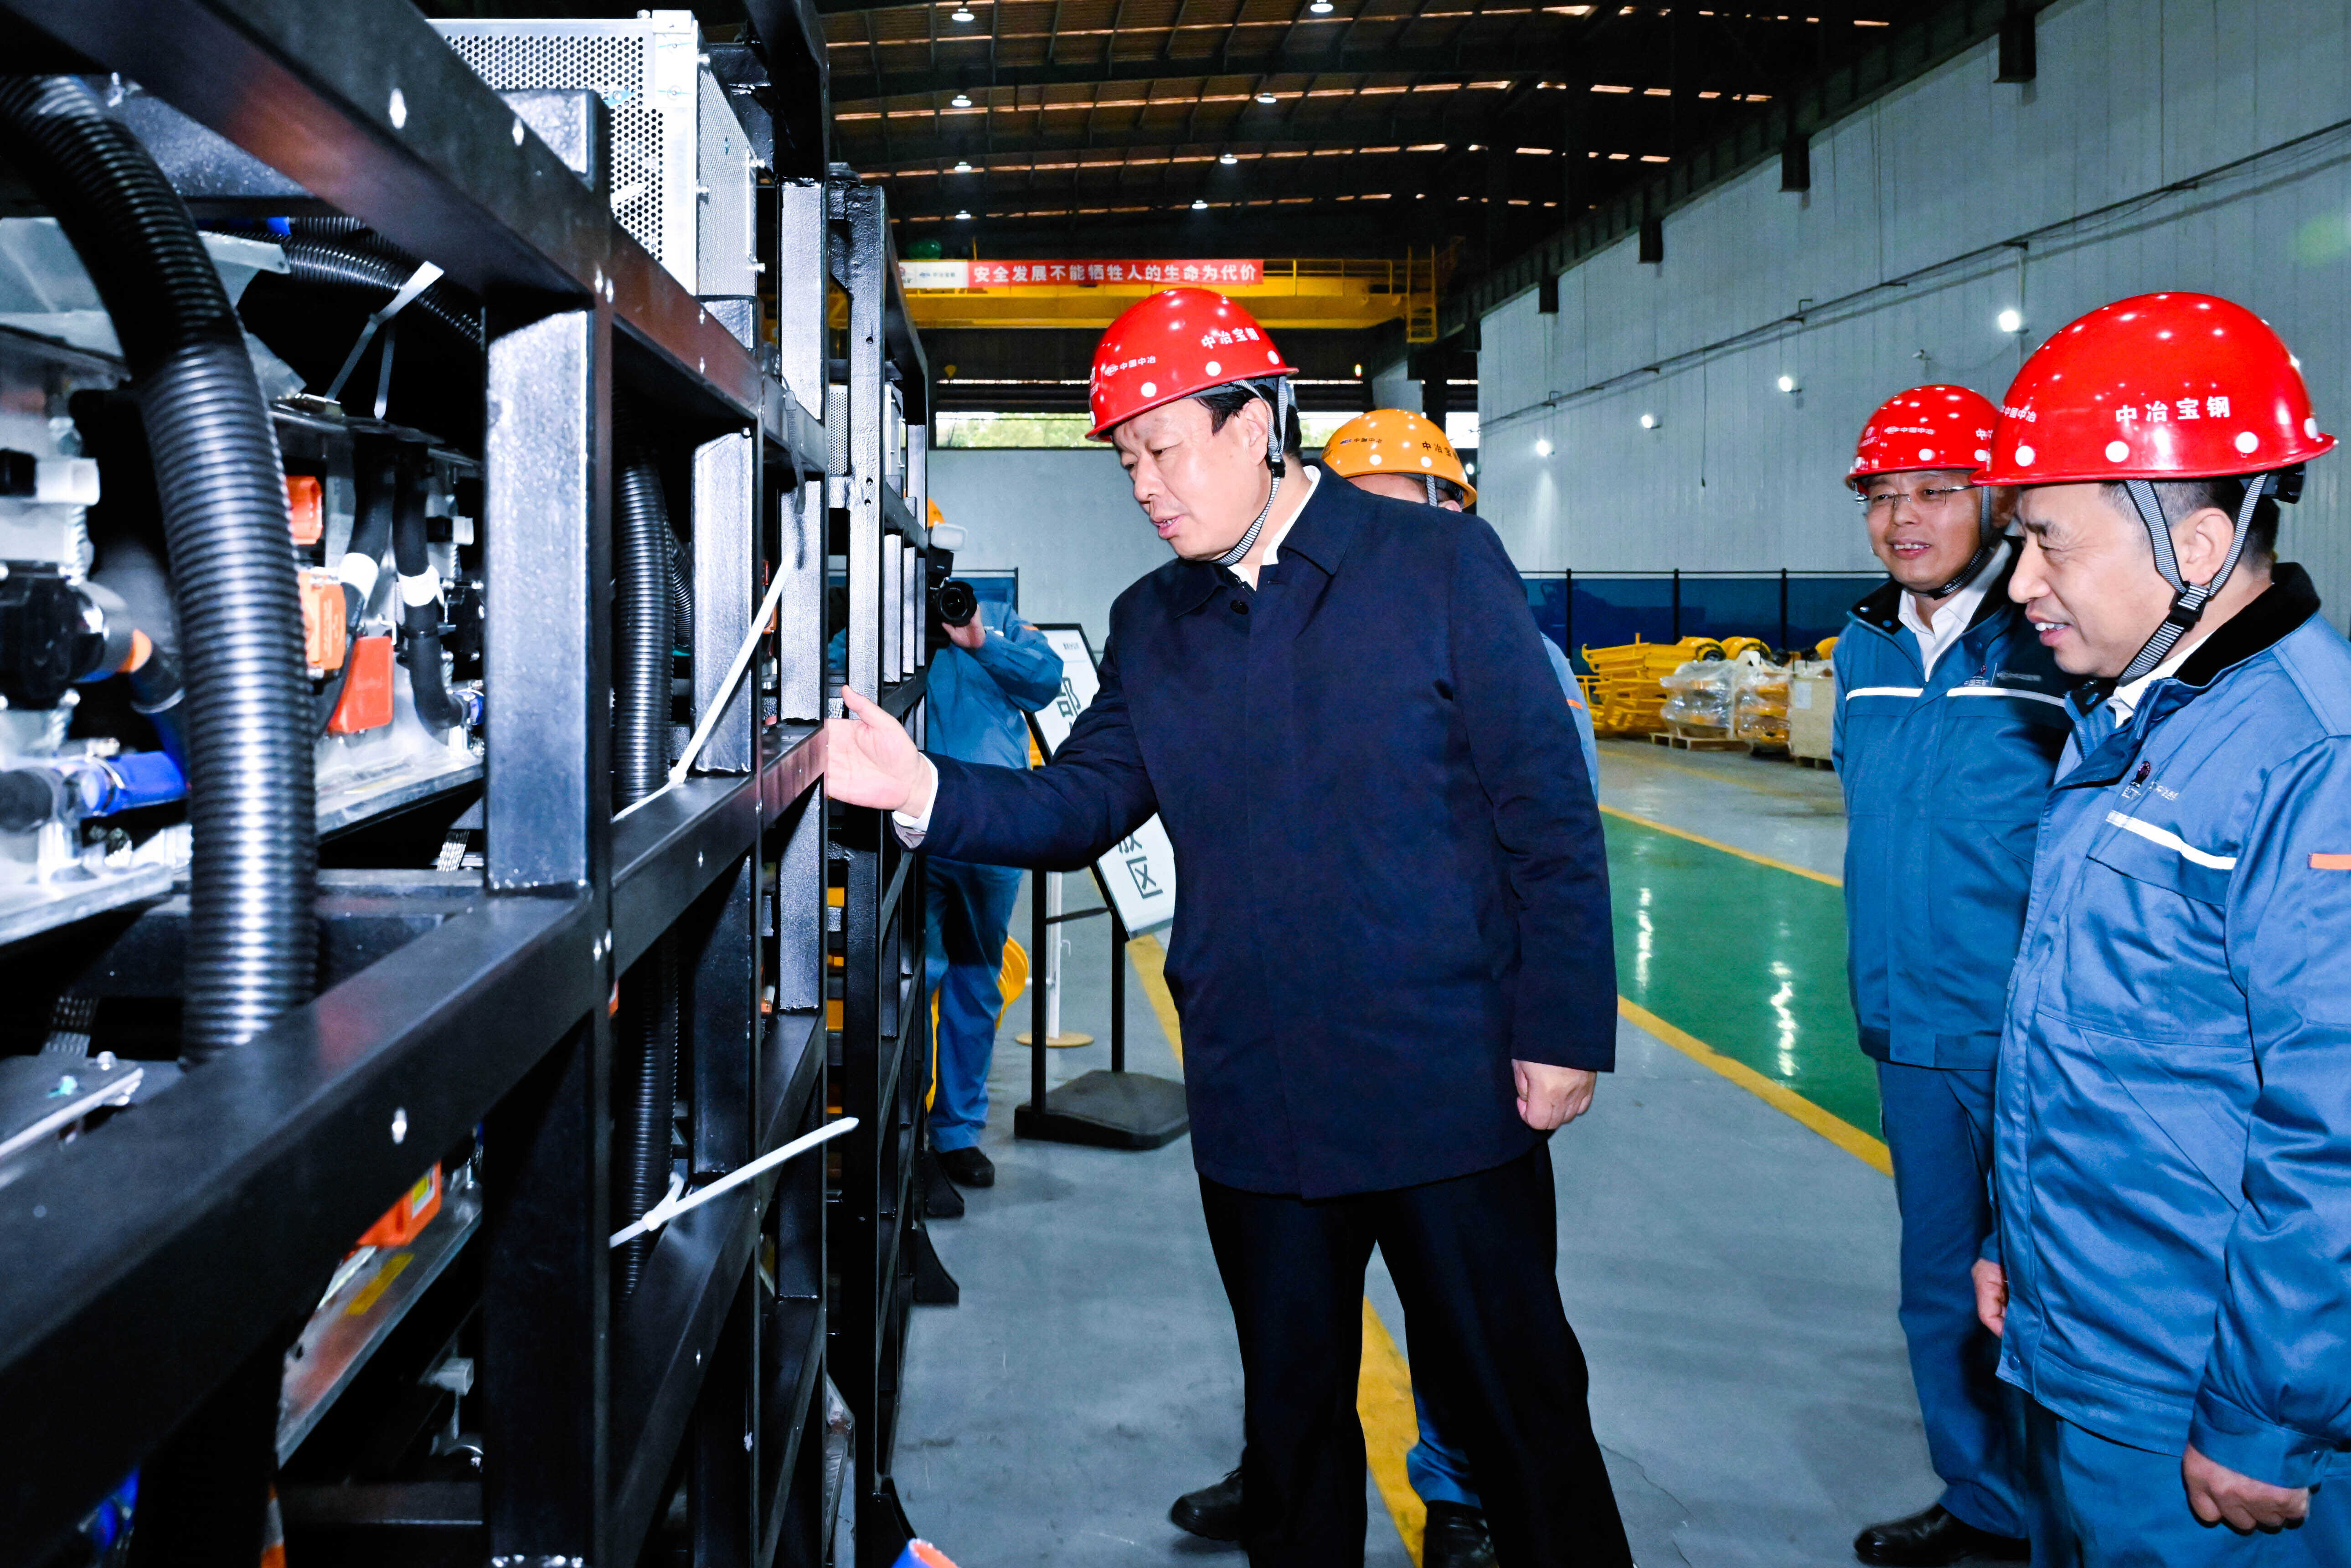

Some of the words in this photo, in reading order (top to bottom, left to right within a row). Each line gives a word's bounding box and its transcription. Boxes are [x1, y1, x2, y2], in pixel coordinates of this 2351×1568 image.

[974, 264, 1256, 283] 安全发展不能牺牲人的生命为代价
[1201, 327, 1260, 349] 中冶宝钢
[2115, 396, 2231, 427] 中冶宝钢
